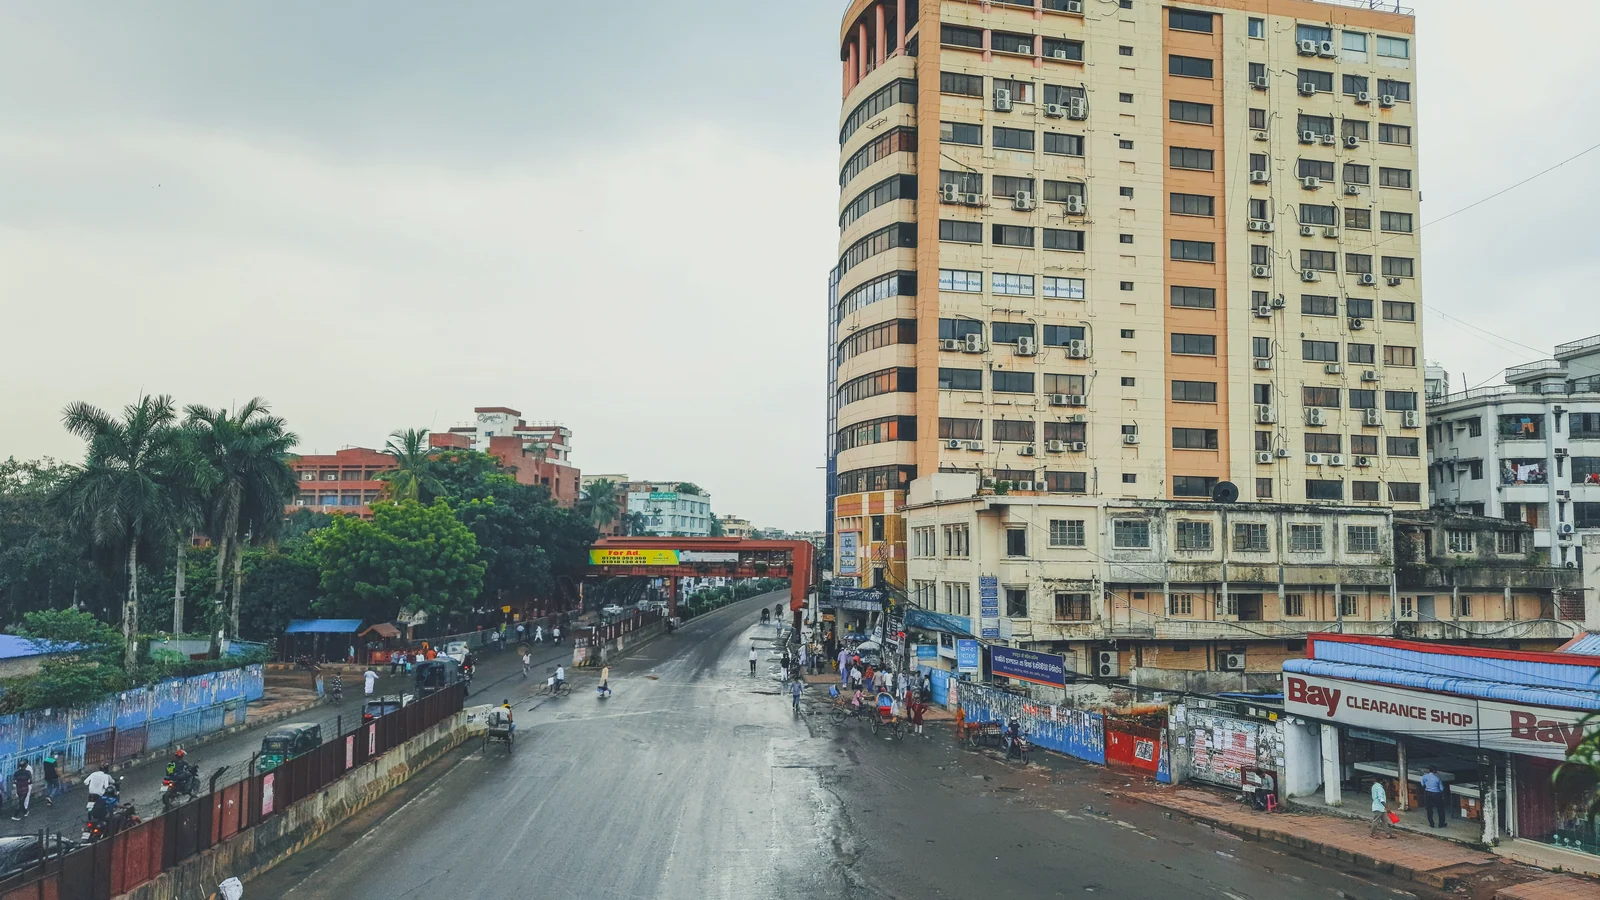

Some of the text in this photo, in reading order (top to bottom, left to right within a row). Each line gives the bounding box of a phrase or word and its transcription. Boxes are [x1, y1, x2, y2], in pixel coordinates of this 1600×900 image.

[1288, 677, 1472, 727] Bay CLEARANCE SHOP
[1510, 710, 1584, 757] Bay
